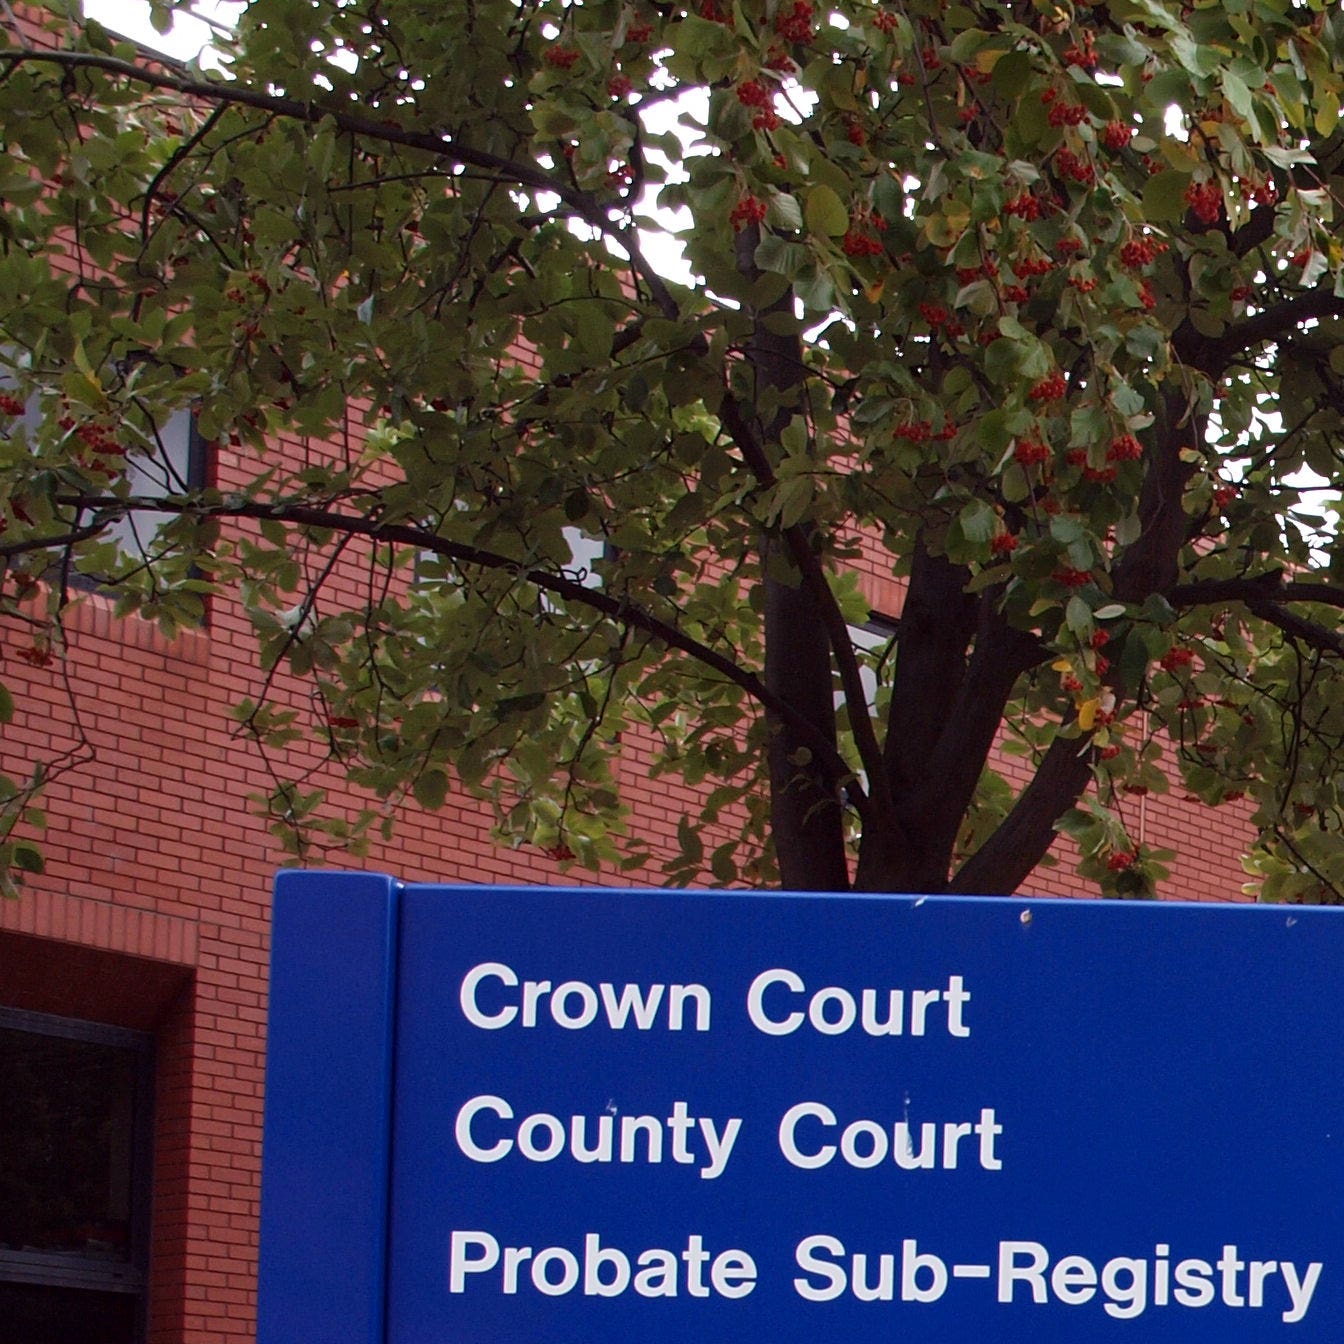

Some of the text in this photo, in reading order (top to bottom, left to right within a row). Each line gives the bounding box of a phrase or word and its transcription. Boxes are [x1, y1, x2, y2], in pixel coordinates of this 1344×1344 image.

[459, 961, 971, 1037] Crown Court
[454, 1094, 1003, 1179] County Court
[449, 1229, 1323, 1323] Probate Sub-Registry
